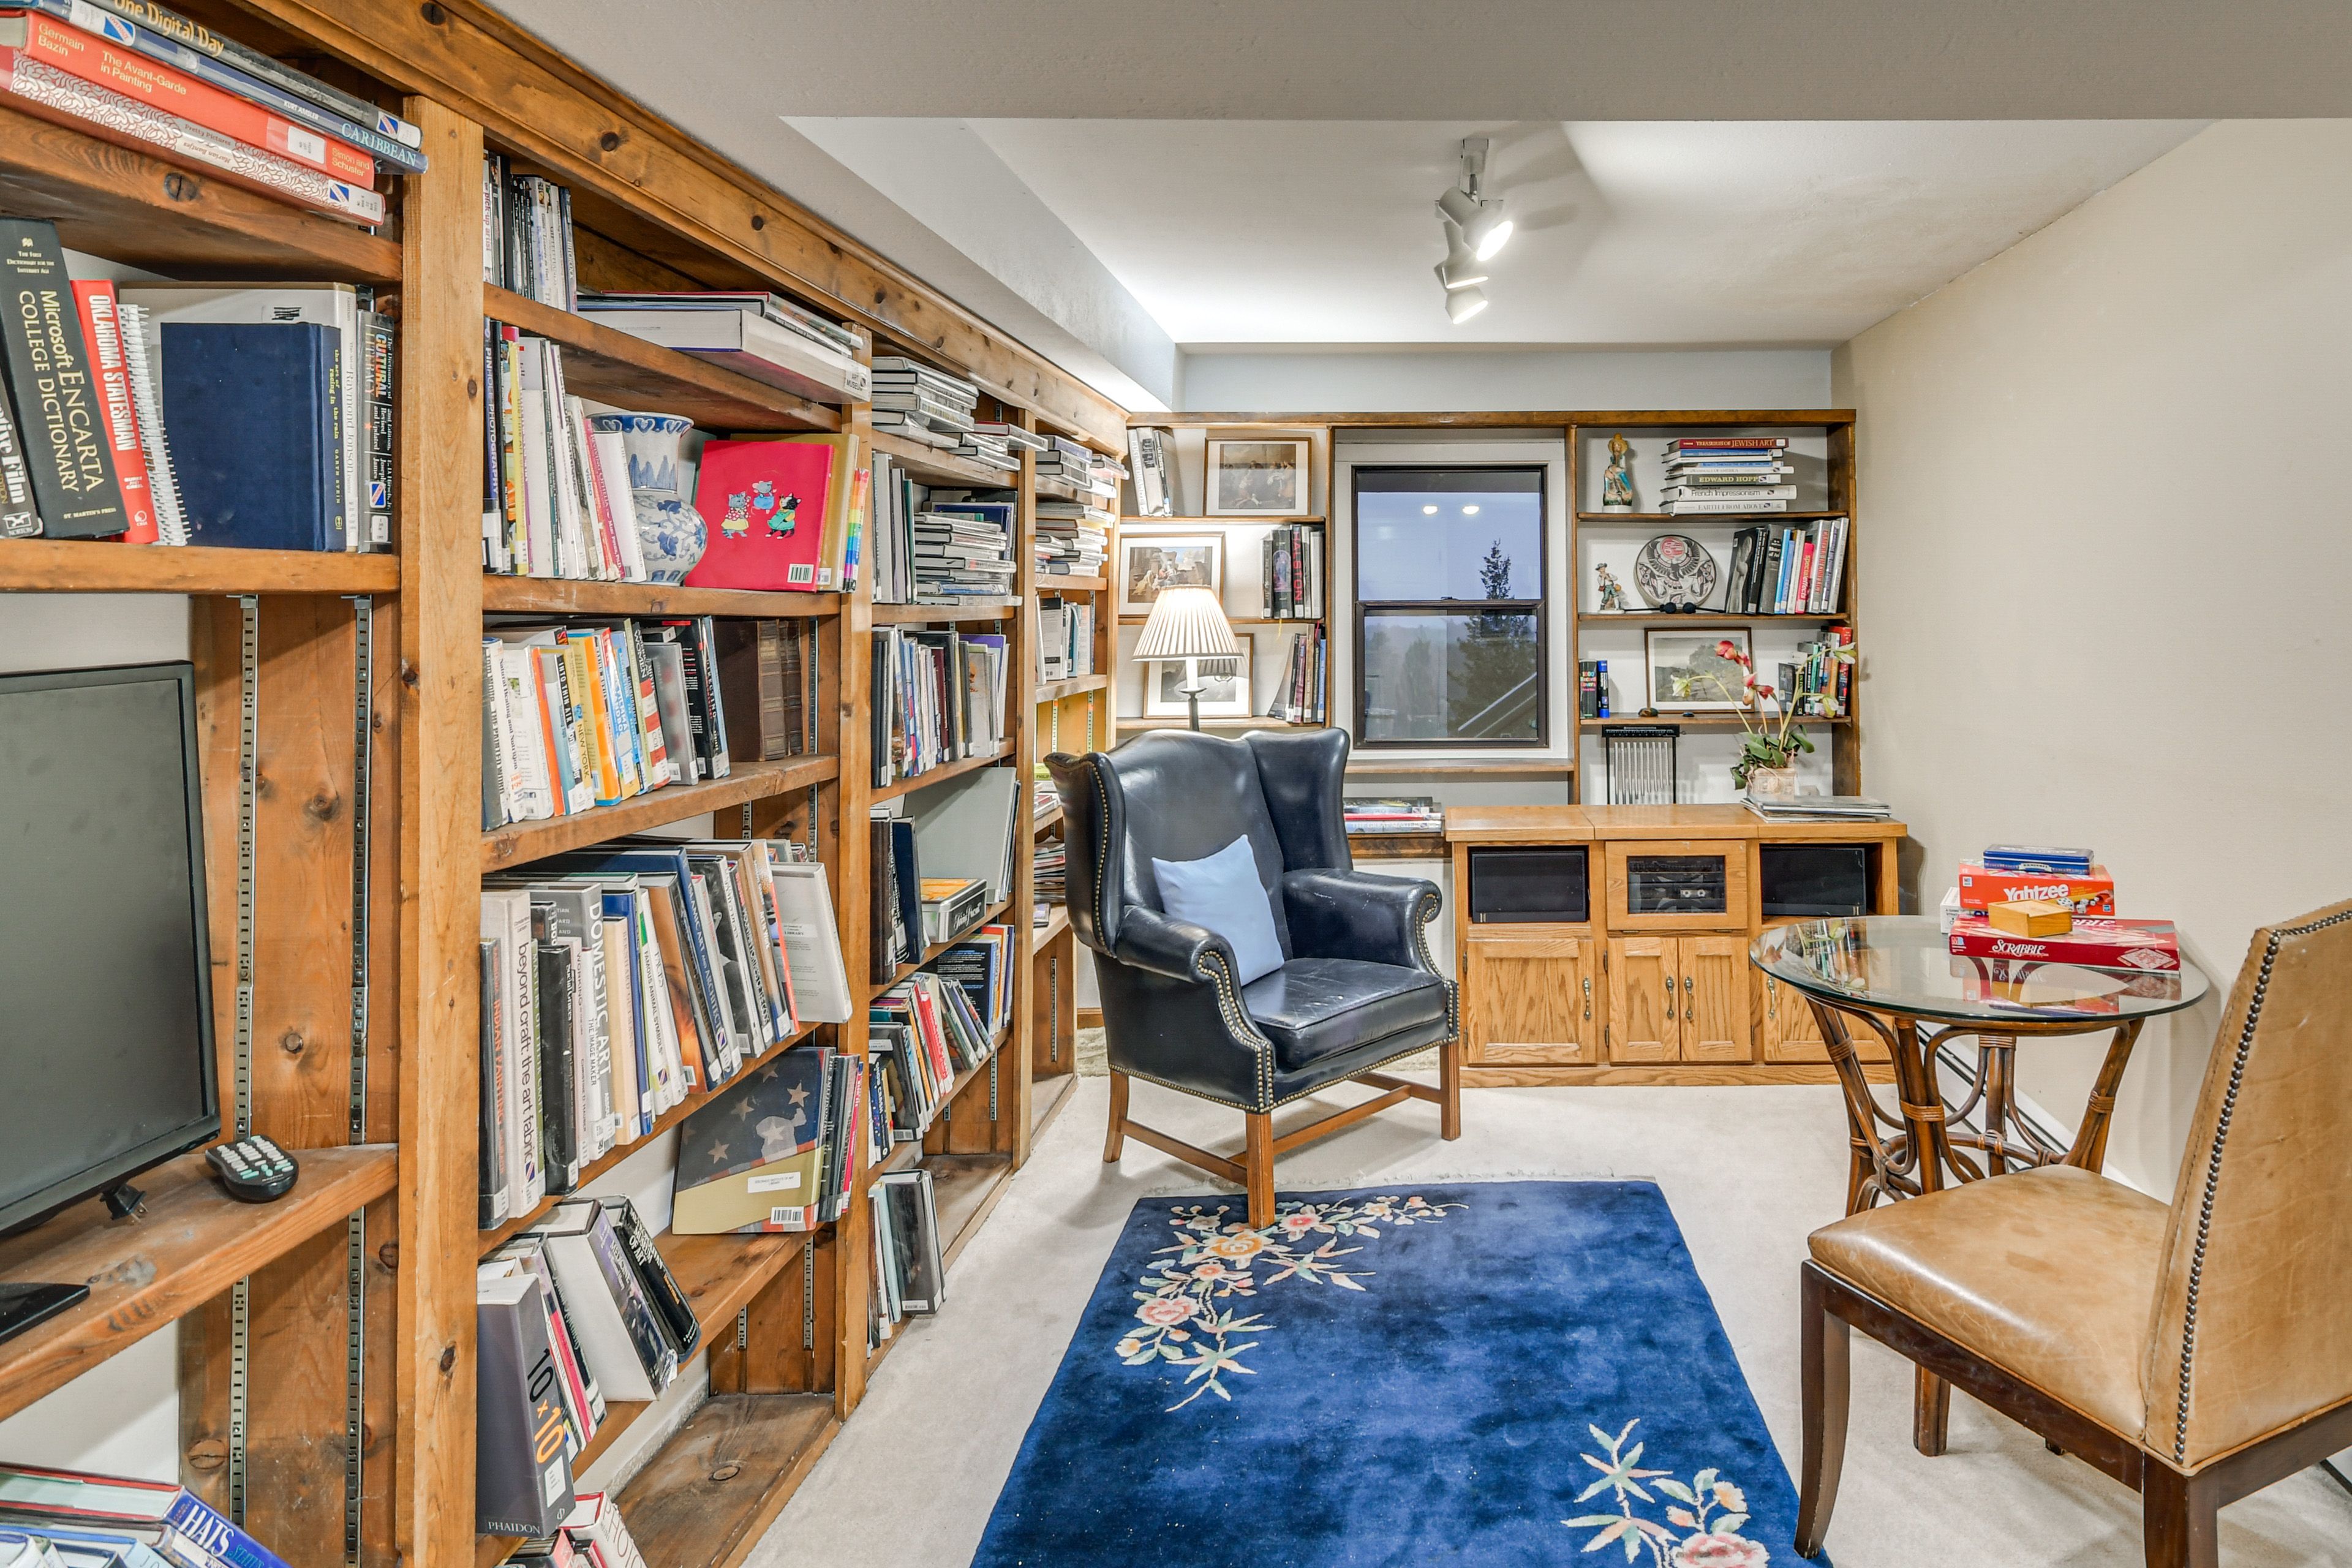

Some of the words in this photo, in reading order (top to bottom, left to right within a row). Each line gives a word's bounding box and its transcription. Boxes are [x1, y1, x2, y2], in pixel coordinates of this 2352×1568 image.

[38, 36, 69, 56] Bazin
[39, 23, 84, 51] Germain
[114, 0, 143, 17] One
[147, 2, 195, 42] Digital
[197, 27, 224, 56] Day
[100, 64, 110, 75] in
[112, 68, 153, 93] Painting
[102, 50, 123, 66] The
[124, 61, 187, 96] Avant-Garde
[284, 100, 298, 111] KURT
[297, 107, 319, 120] AMSLER
[183, 141, 209, 155] Bantjes
[185, 124, 205, 137] Pretty
[206, 132, 232, 146] Pictures
[341, 123, 417, 167] CARIBBEAN
[211, 153, 231, 164] Marian
[332, 148, 354, 164] Simon
[355, 156, 370, 170] and
[332, 158, 364, 176] Schuster
[88, 294, 123, 371] OKLAHOMA
[334, 377, 340, 388] of
[375, 334, 386, 398] CULTURAL
[486, 347, 494, 403] PINHOLE
[20, 290, 51, 372] COLLEGE
[38, 377, 80, 492] DICTIONARY
[40, 290, 74, 369] Microsoft
[58, 369, 105, 492] ENCARTA
[330, 395, 335, 404] in
[344, 371, 355, 429] Raymond
[103, 371, 137, 451] STATESMAN
[489, 403, 498, 494] PHOTOGRAPHY
[1, 456, 26, 505] Film
[1714, 489, 1761, 498] Impressionism
[9, 526, 33, 535] NORTON
[76, 510, 100, 518] MARTIN'S
[1293, 531, 1303, 601] HALSTON
[635, 631, 646, 679] WOMEN
[580, 748, 590, 778] YORK
[2003, 883, 2069, 901] Yahtzee
[589, 903, 608, 1025] DOMESTIC
[644, 950, 652, 982] FAMOUS
[687, 881, 701, 929] ISLAMIC
[696, 930, 705, 954] ART
[704, 969, 723, 1032] ARCHITECT
[1992, 939, 2046, 957] SCRABBLE
[518, 941, 530, 1009] beyond
[576, 953, 585, 1006] WORKING
[648, 984, 658, 1019] ANIMAL
[493, 998, 502, 1052] INDIAN
[519, 1011, 531, 1055] craft:
[535, 1012, 540, 1030] OF
[652, 1020, 664, 1055] SYMBOLS
[521, 1057, 532, 1085] the
[596, 1035, 612, 1075] ART
[521, 1087, 532, 1112] art
[522, 1112, 533, 1162] fabric
[629, 1208, 664, 1270] METROPOLITAN
[629, 1235, 639, 1250] OF
[633, 1226, 654, 1264] MUSEUM
[633, 1248, 647, 1266] ART
[610, 1239, 631, 1284] MEDICINE
[534, 1407, 565, 1463] 10
[184, 1504, 235, 1558] HATS
[488, 1521, 541, 1535] PHAIDON
